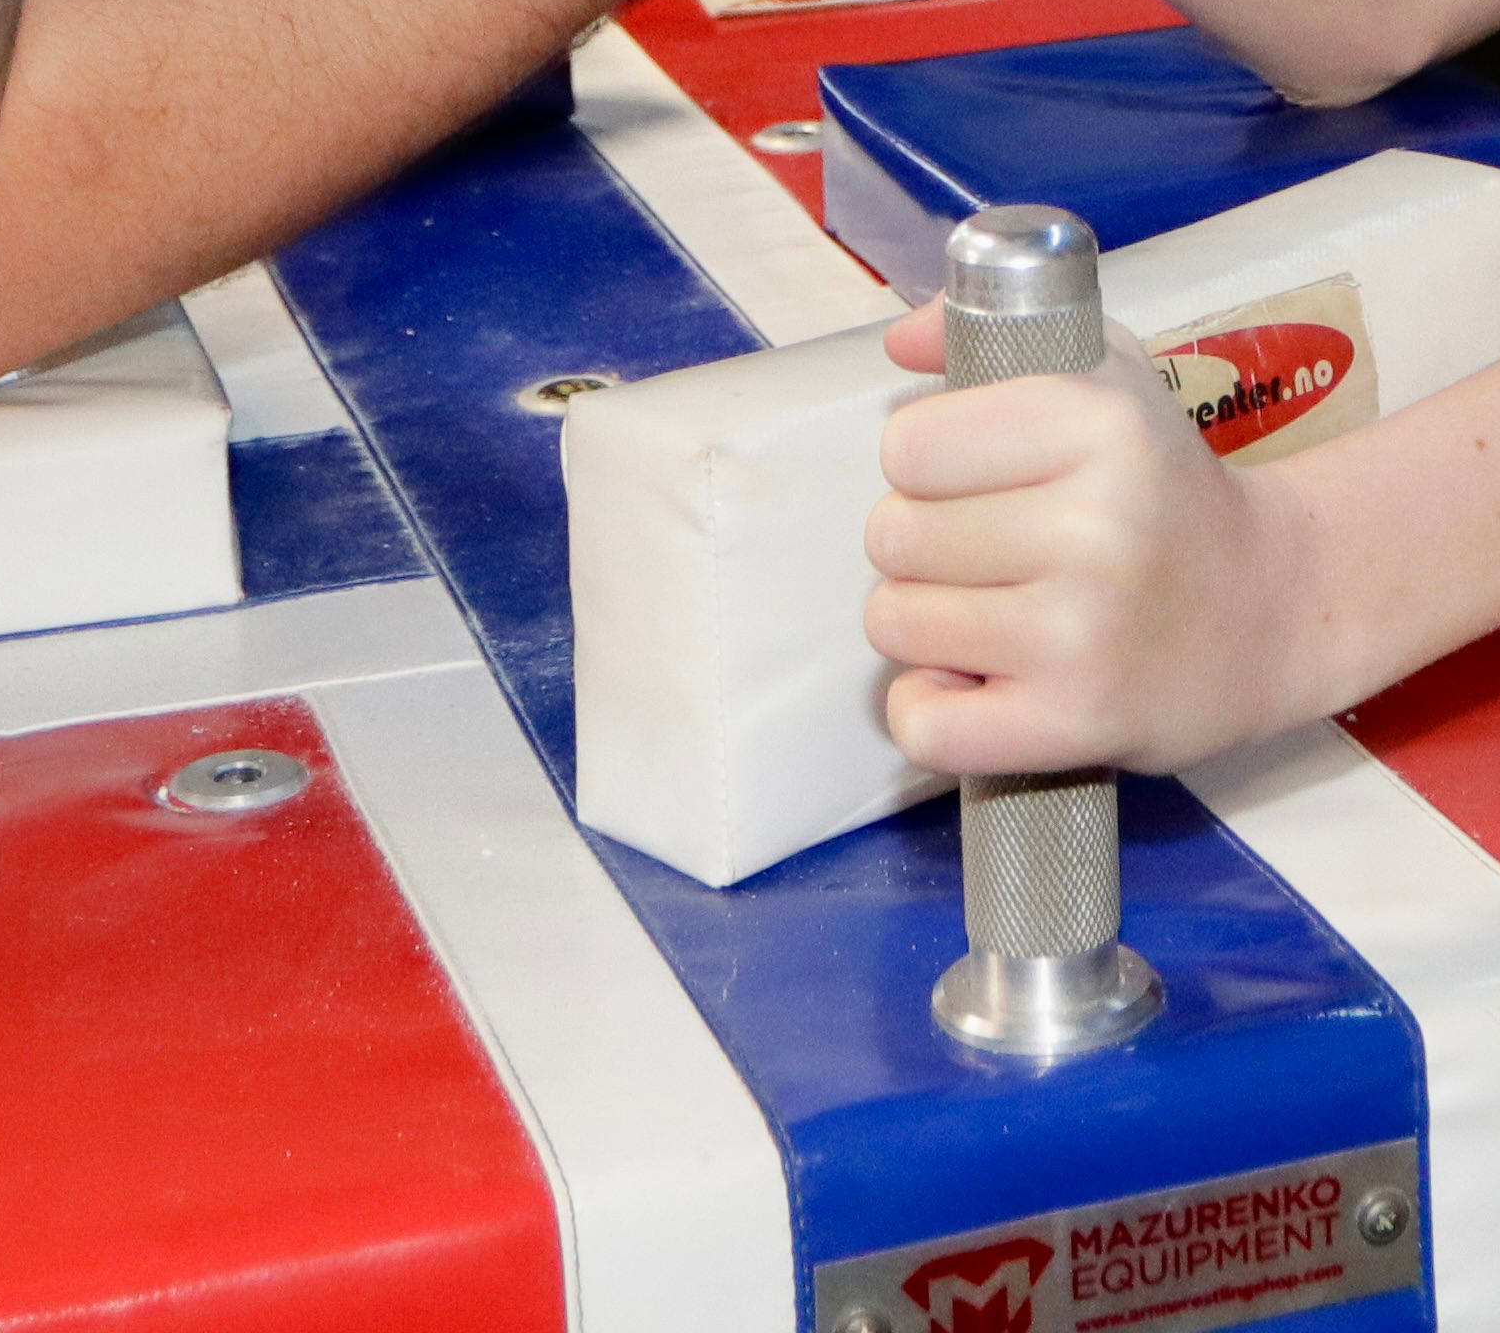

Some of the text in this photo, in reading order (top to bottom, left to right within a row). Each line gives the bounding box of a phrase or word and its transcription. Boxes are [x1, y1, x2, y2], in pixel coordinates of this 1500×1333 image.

[1187, 359, 1334, 429] enter.no
[1070, 1176, 1341, 1261] MAZURENKO
[1071, 1211, 1340, 1300] EQUIPMENT
